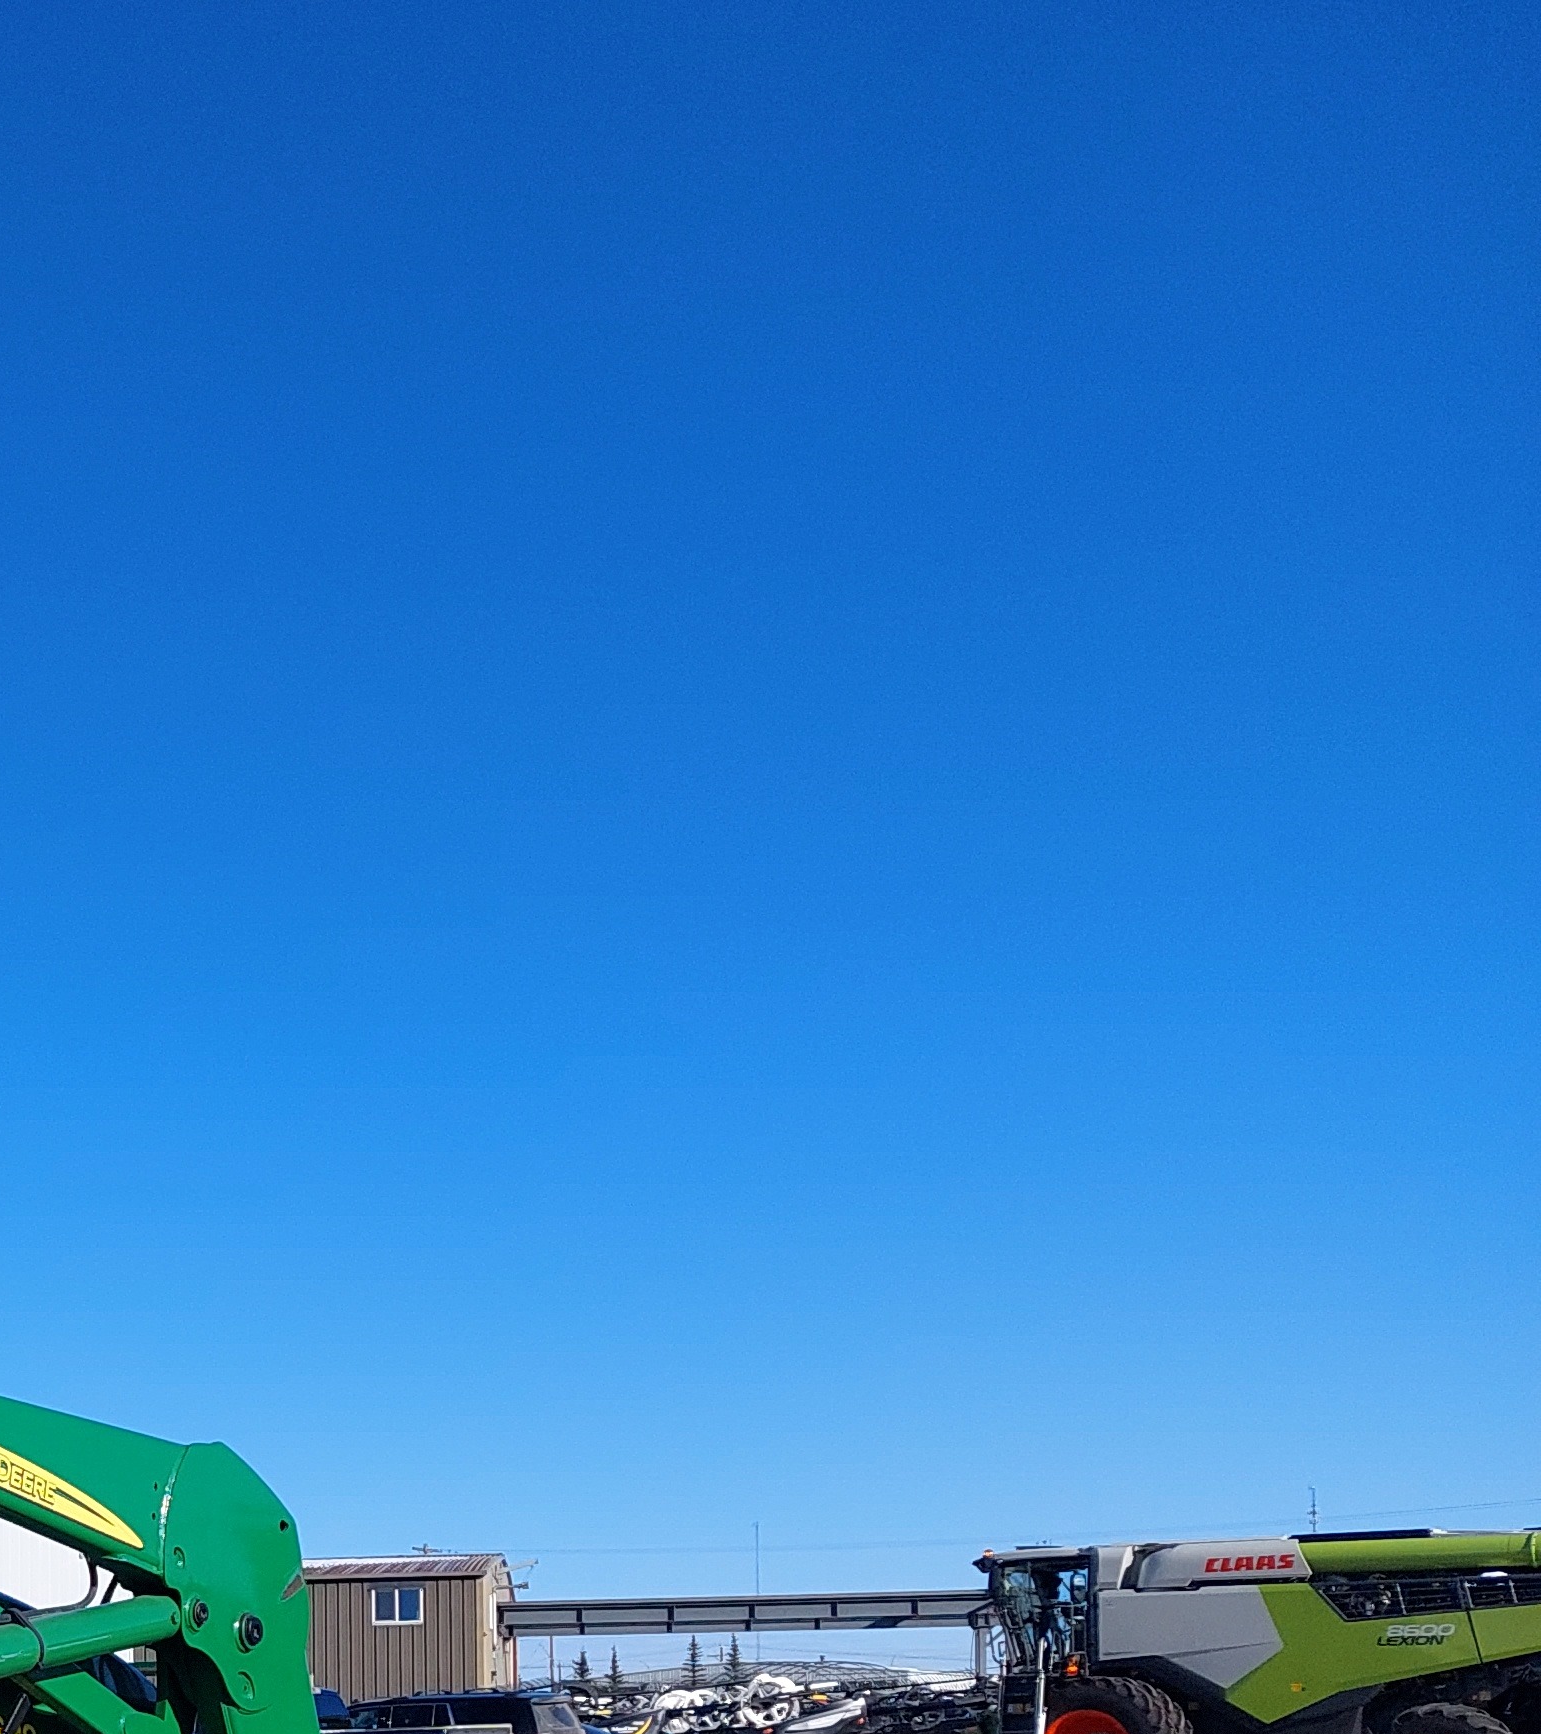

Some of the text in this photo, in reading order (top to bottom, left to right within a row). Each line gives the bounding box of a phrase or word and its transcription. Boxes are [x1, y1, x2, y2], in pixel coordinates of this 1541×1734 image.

[1204, 1553, 1295, 1573] CLAAS
[1386, 1624, 1456, 1637] 8600
[1377, 1635, 1445, 1646] LEXION
